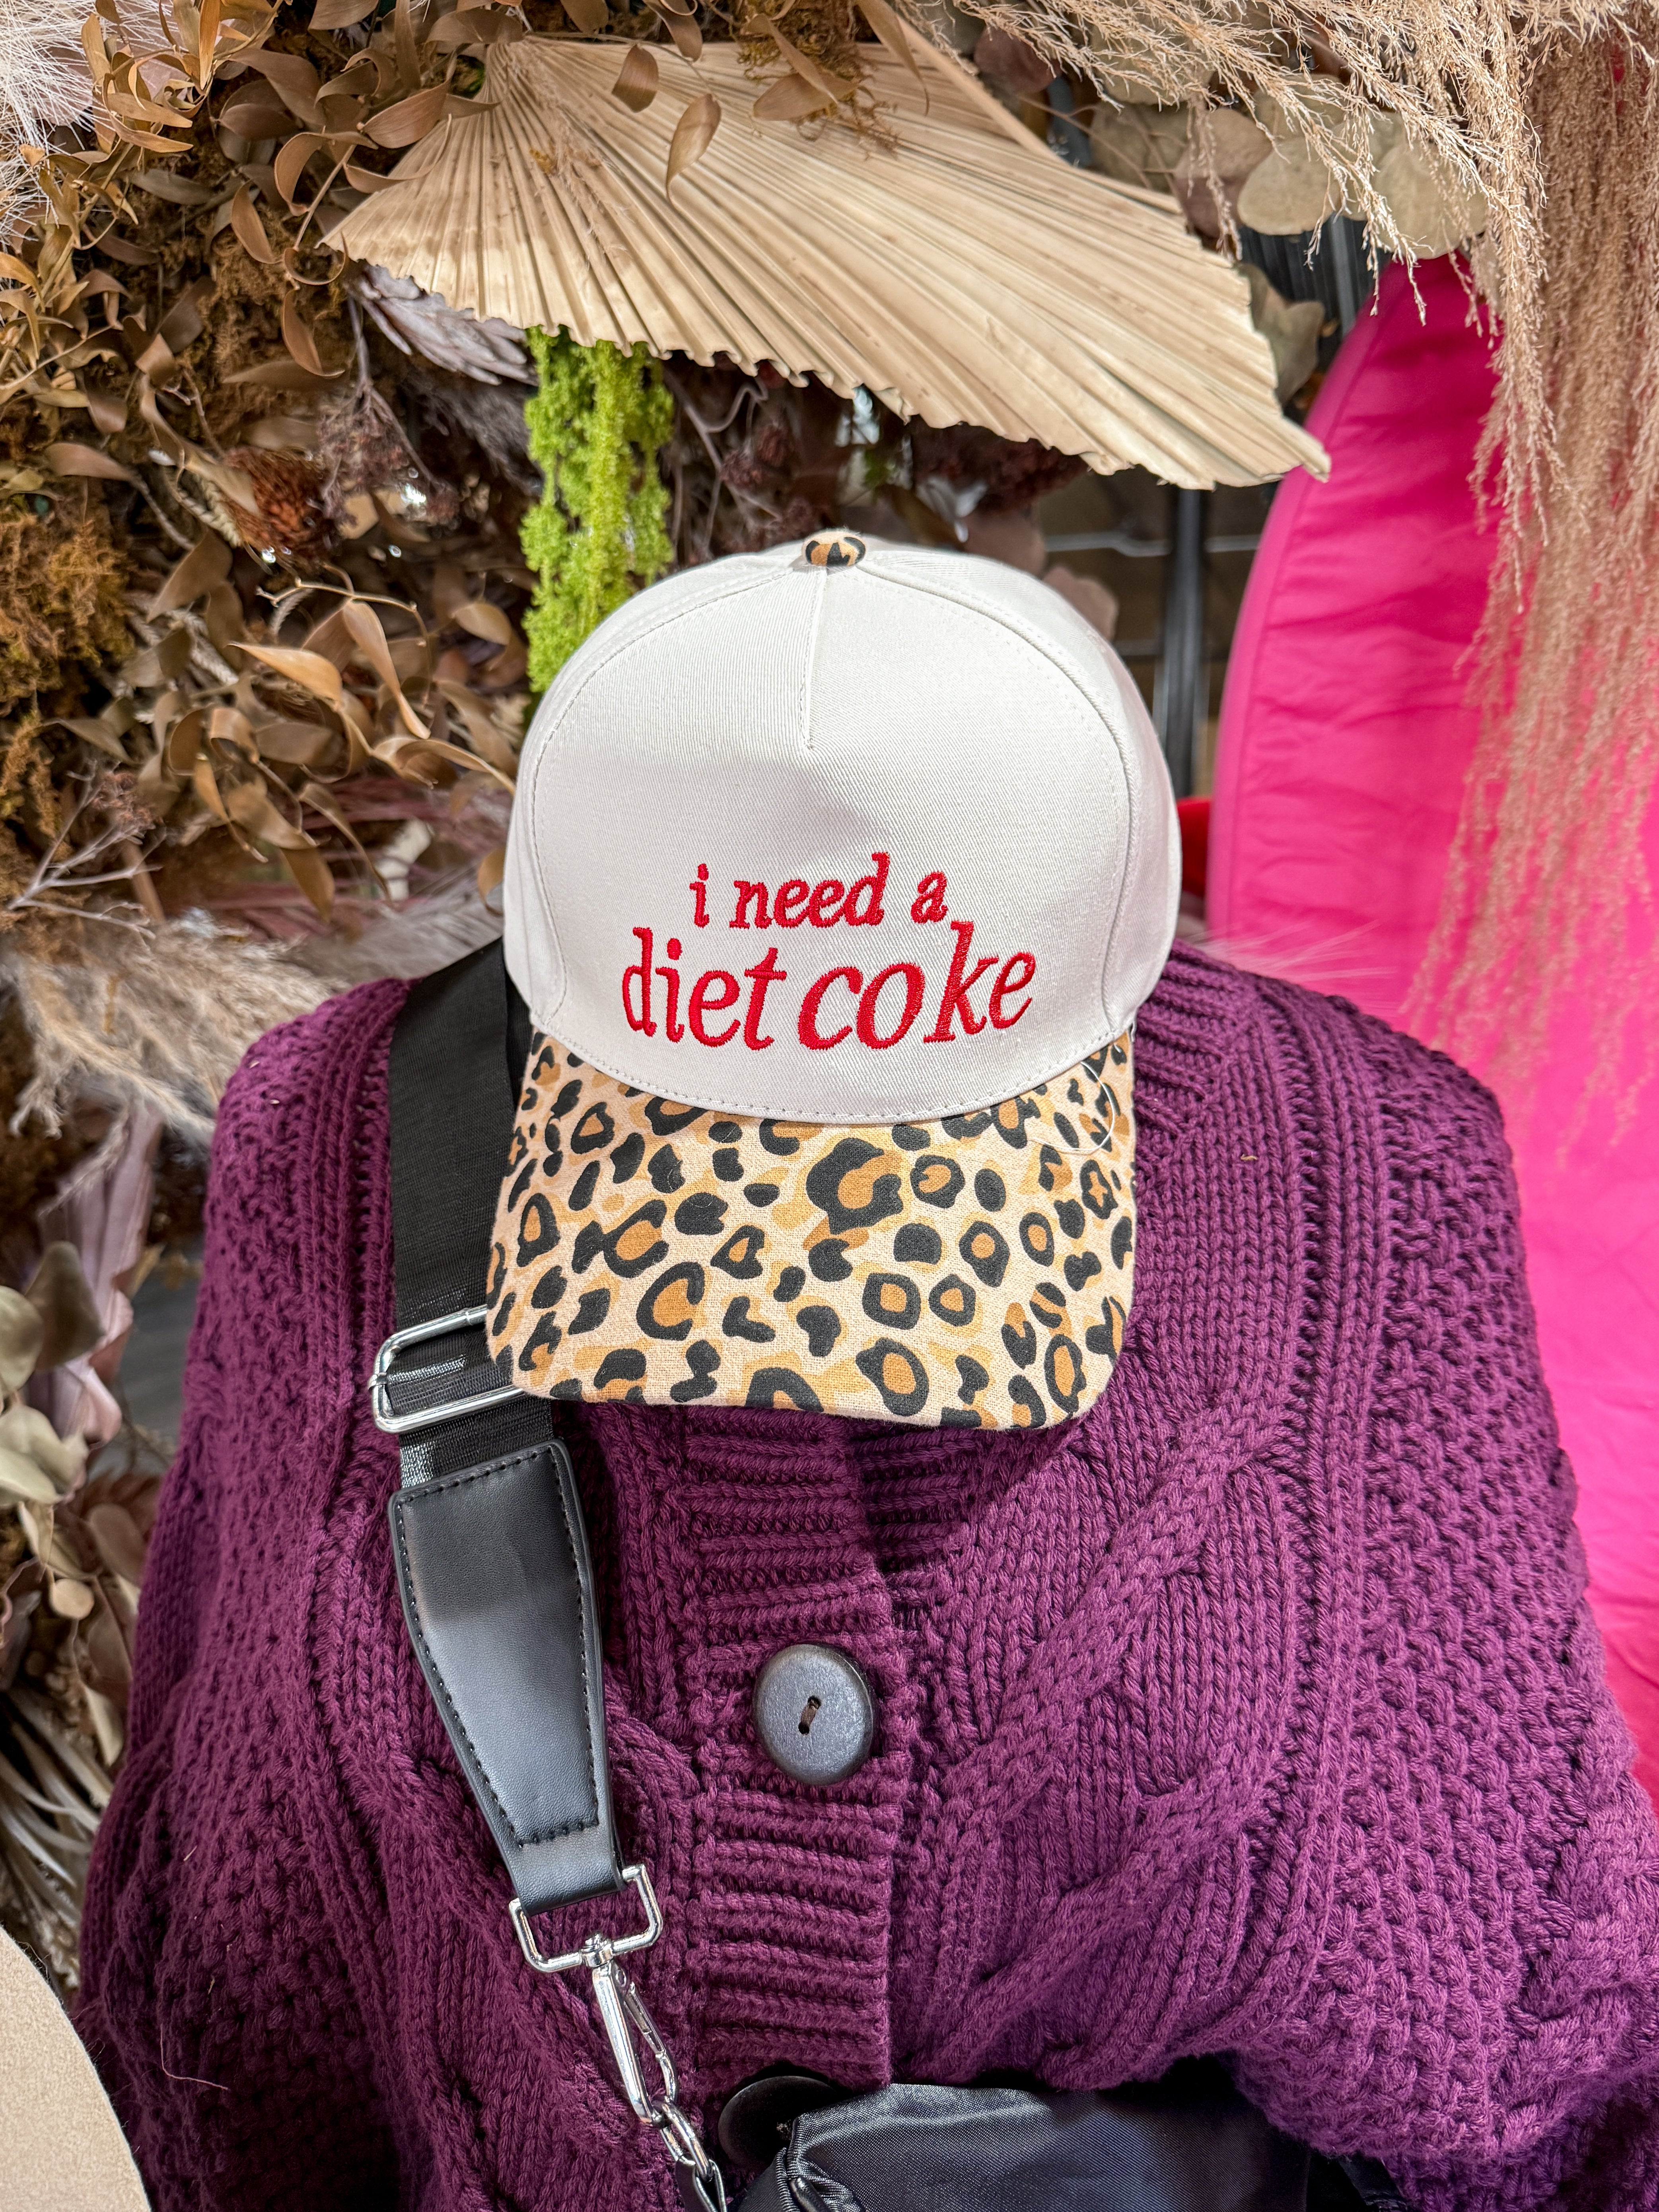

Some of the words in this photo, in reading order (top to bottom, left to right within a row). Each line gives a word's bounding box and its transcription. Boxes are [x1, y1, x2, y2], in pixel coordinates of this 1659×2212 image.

[689, 863, 710, 928] i
[729, 852, 891, 929] need
[910, 871, 948, 924] a
[621, 927, 787, 1051] diet
[797, 920, 1036, 1051] coke
